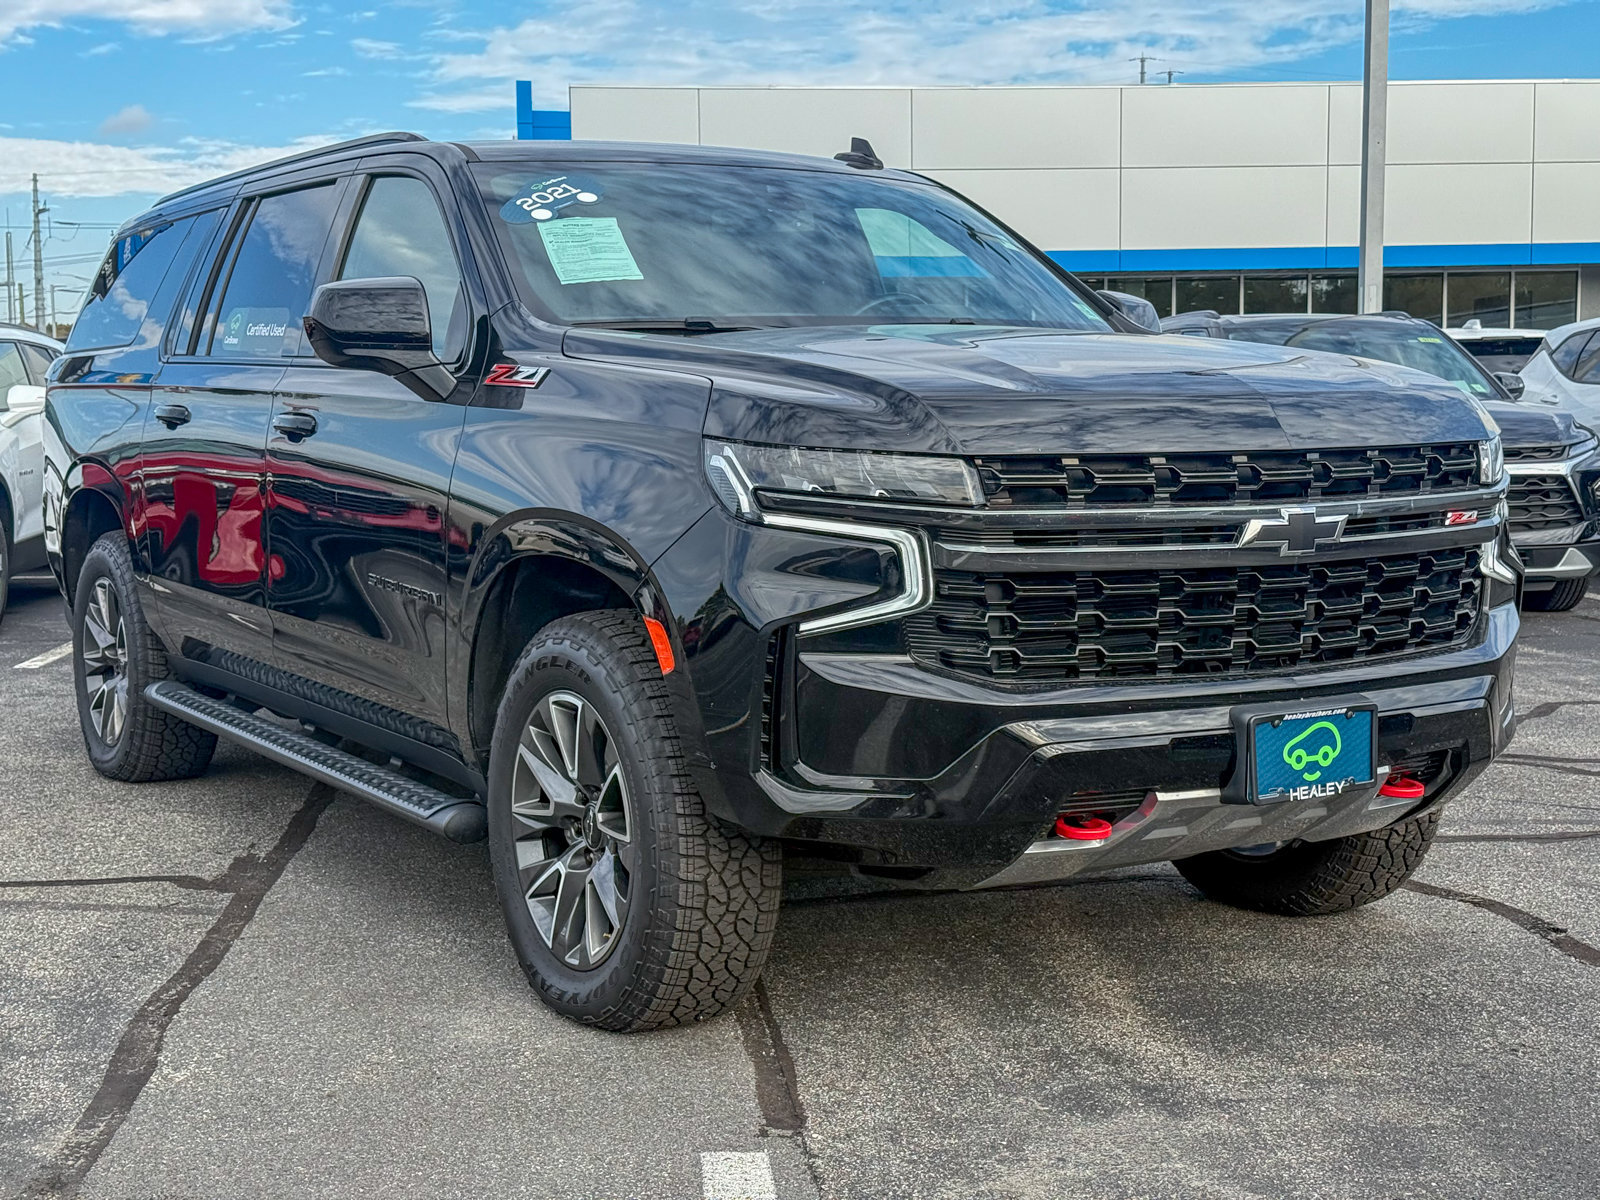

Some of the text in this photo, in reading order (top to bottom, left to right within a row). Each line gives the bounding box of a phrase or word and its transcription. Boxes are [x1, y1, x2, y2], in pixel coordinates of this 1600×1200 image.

[516, 184, 582, 211] 2021
[246, 323, 286, 336] Certified Used
[367, 572, 442, 608] SUBURBAN
[1289, 780, 1345, 802] HEALEY
